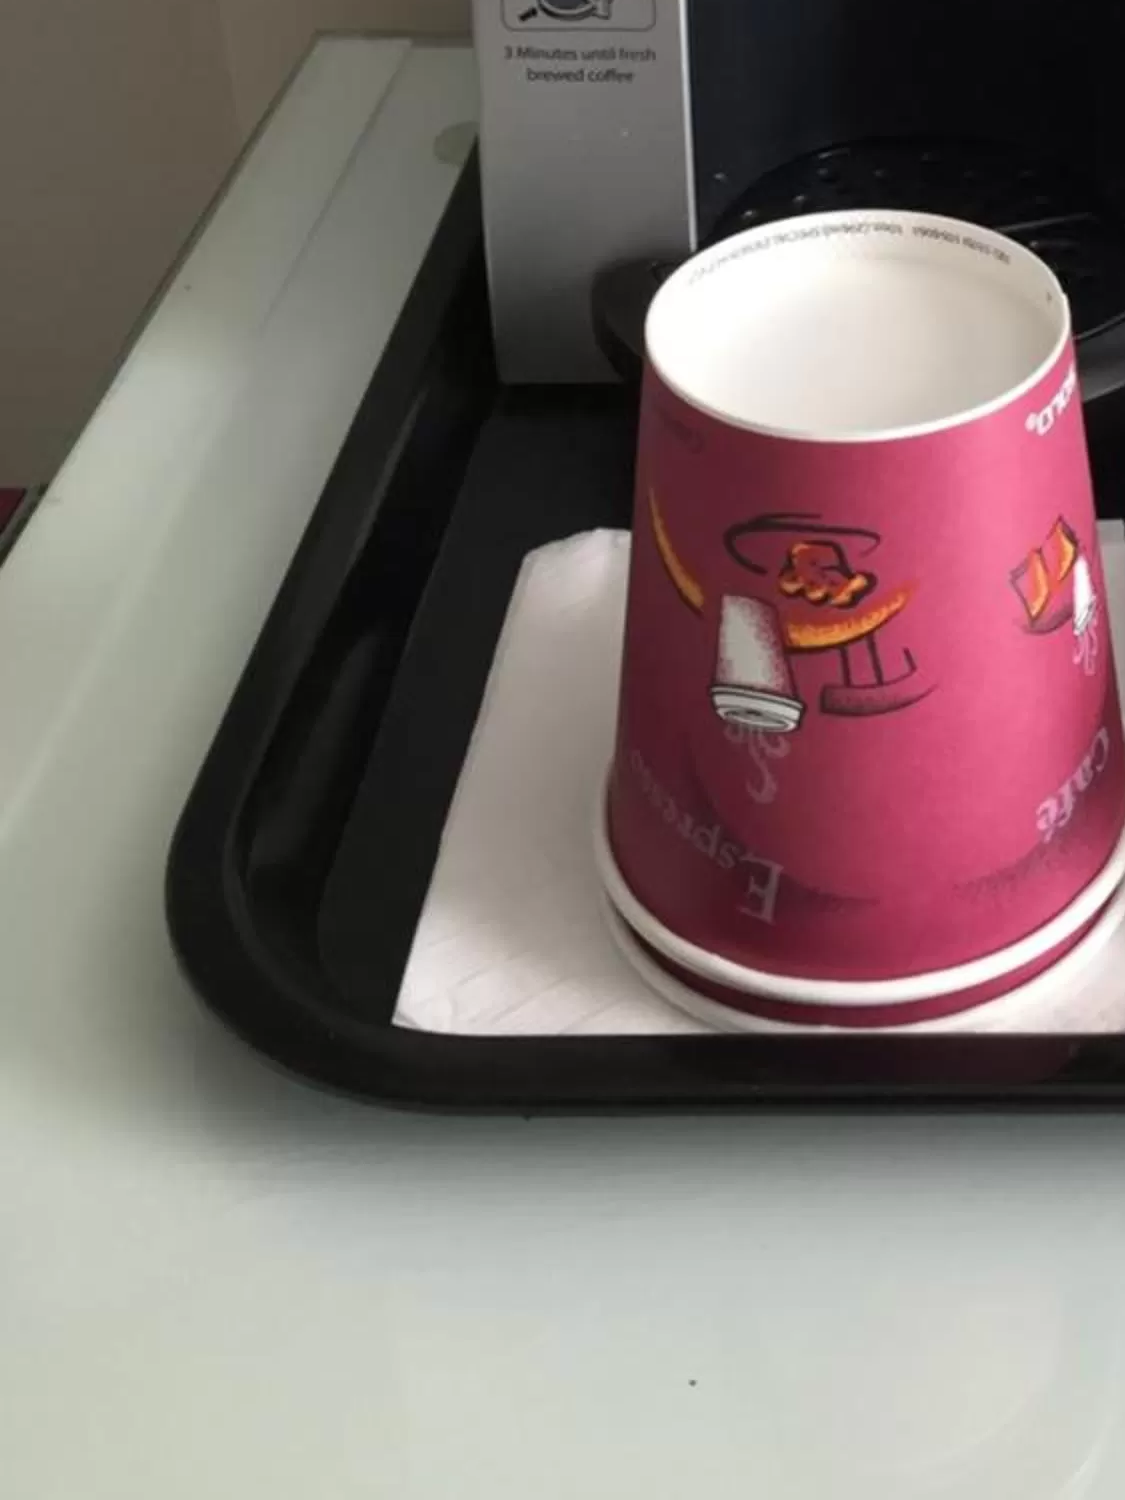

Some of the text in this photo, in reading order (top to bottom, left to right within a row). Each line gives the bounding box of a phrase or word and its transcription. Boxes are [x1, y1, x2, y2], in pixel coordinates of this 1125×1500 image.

[504, 45, 657, 62] 3 Minutes until fresh
[526, 67, 635, 84] brewed coffee
[1036, 726, 1110, 843] Café
